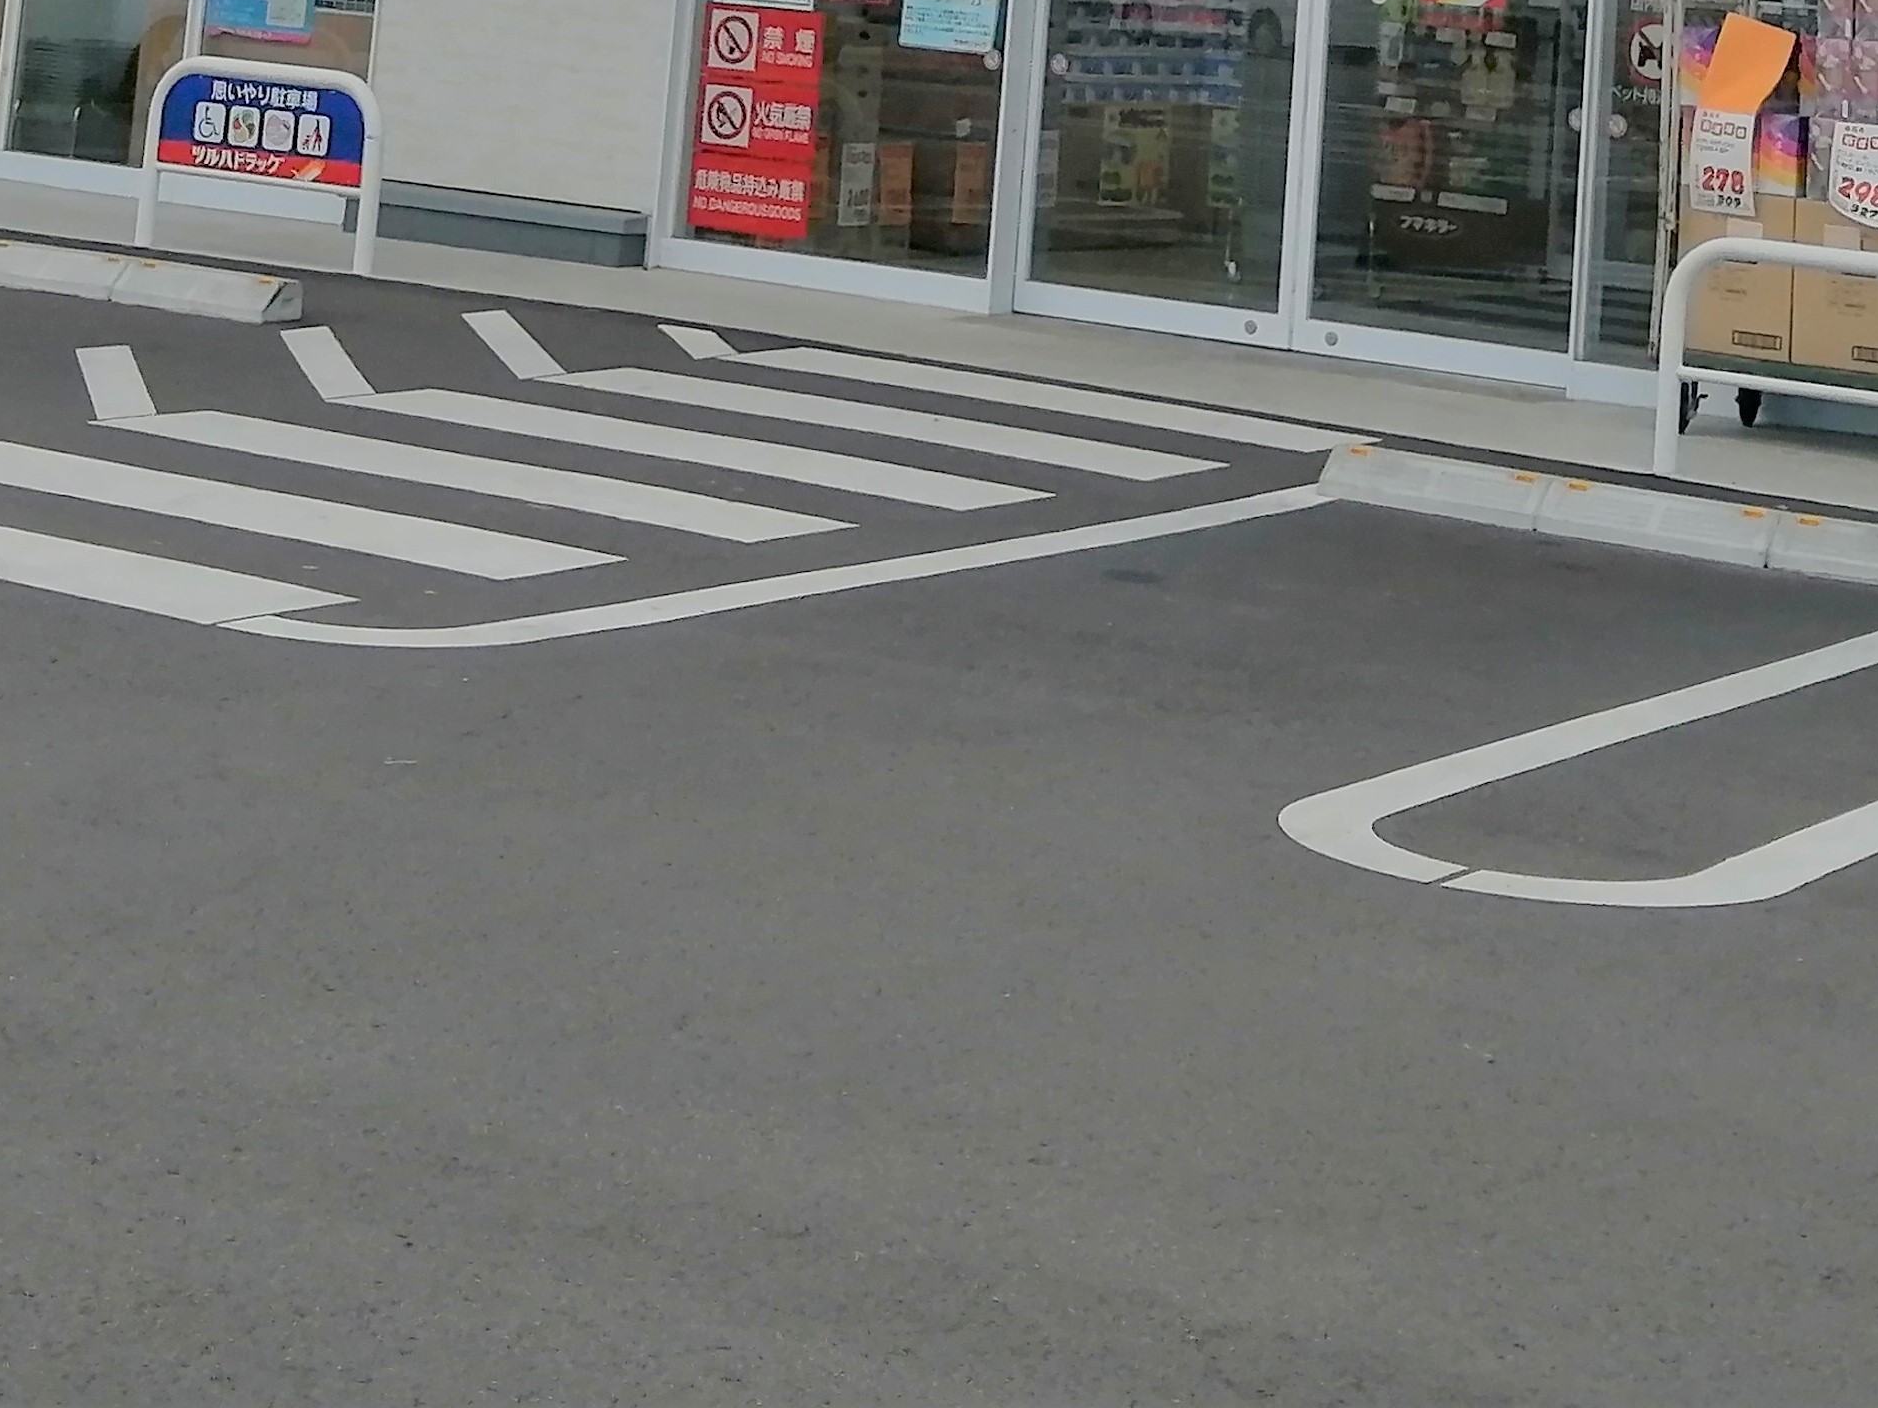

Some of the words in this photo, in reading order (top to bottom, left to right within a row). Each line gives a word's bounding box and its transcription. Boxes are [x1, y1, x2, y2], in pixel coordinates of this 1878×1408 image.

[191, 144, 285, 174] ツルハドラッグ
